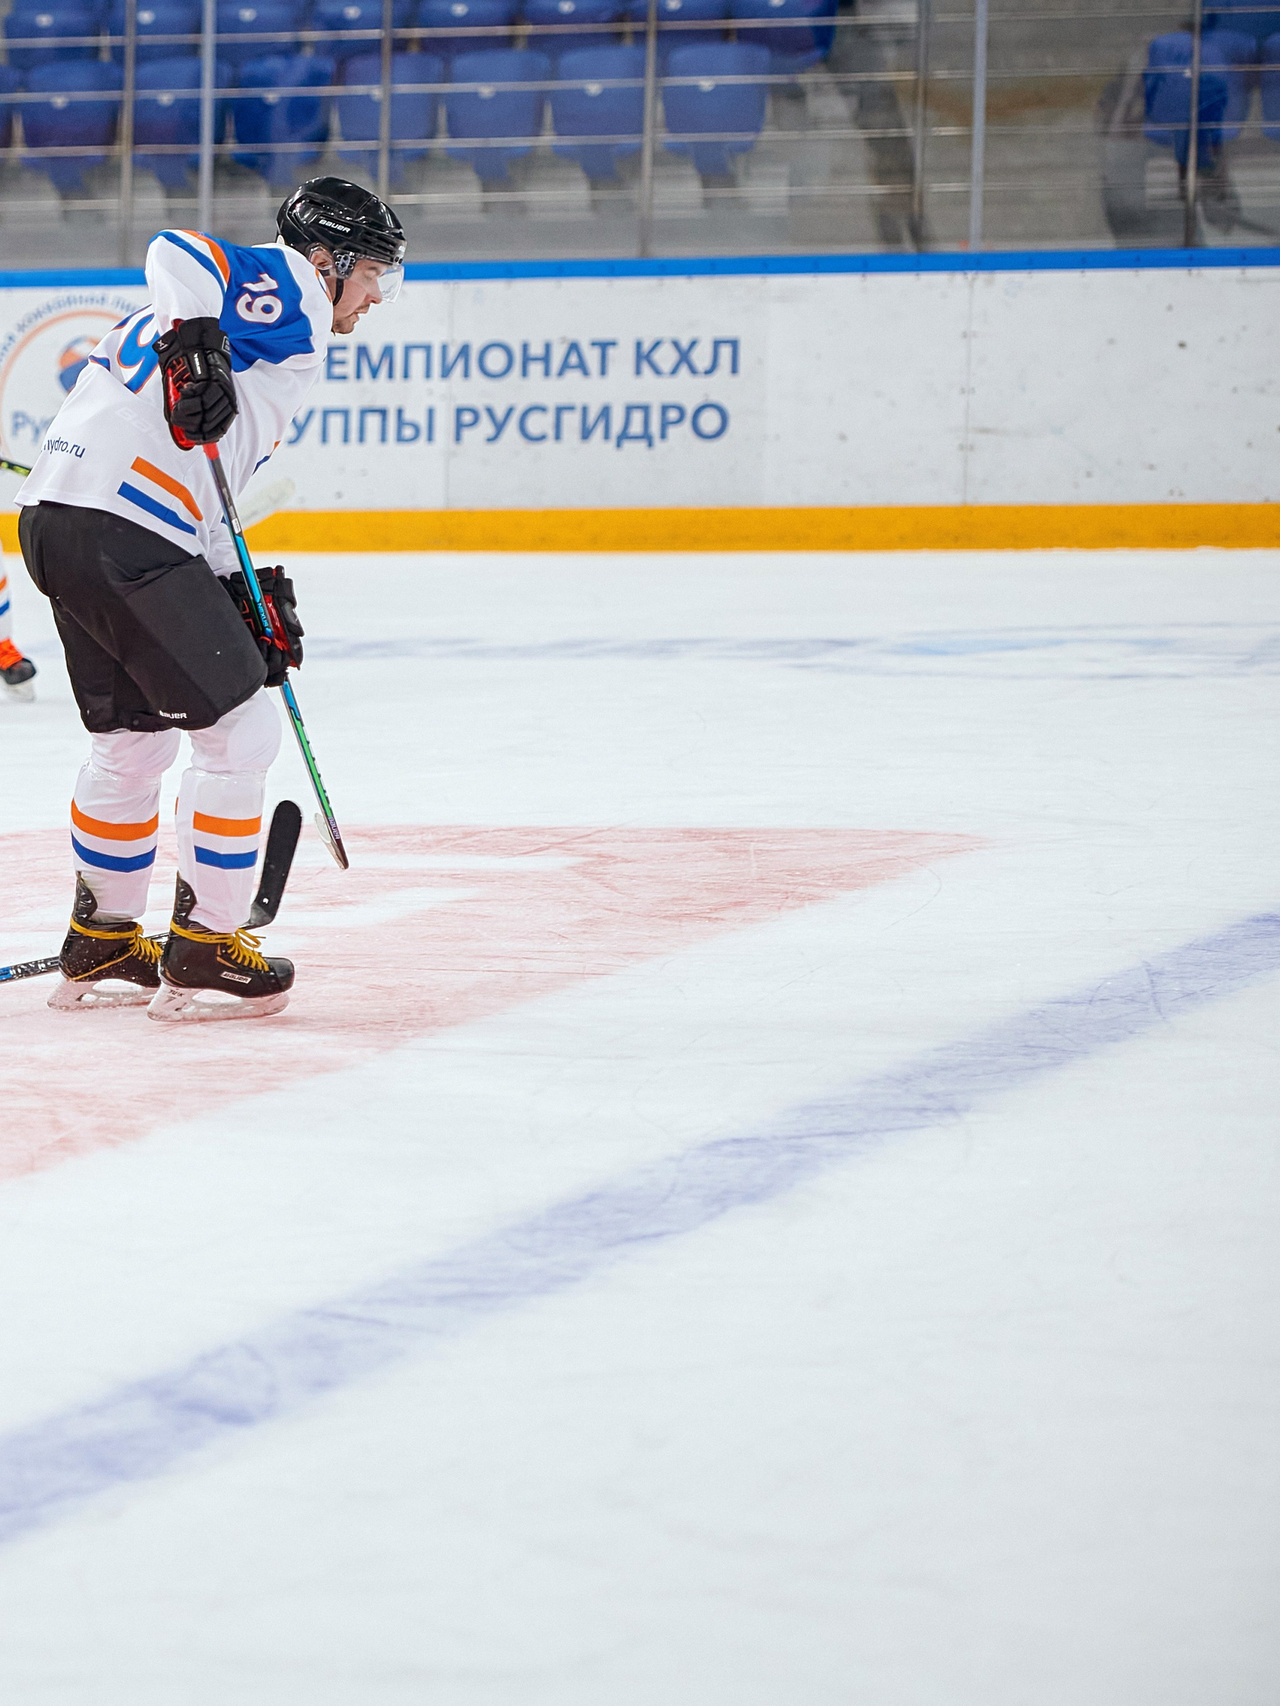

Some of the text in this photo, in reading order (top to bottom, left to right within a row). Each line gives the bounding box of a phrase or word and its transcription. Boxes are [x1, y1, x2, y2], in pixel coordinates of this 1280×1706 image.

[318, 219, 351, 233] BAUER
[236, 272, 283, 324] 19
[326, 336, 741, 381] ЕМПИОНАТ КХЛ
[43, 436, 86, 458] ydro.ru
[287, 401, 730, 449] УППЫ РУСГИДРО
